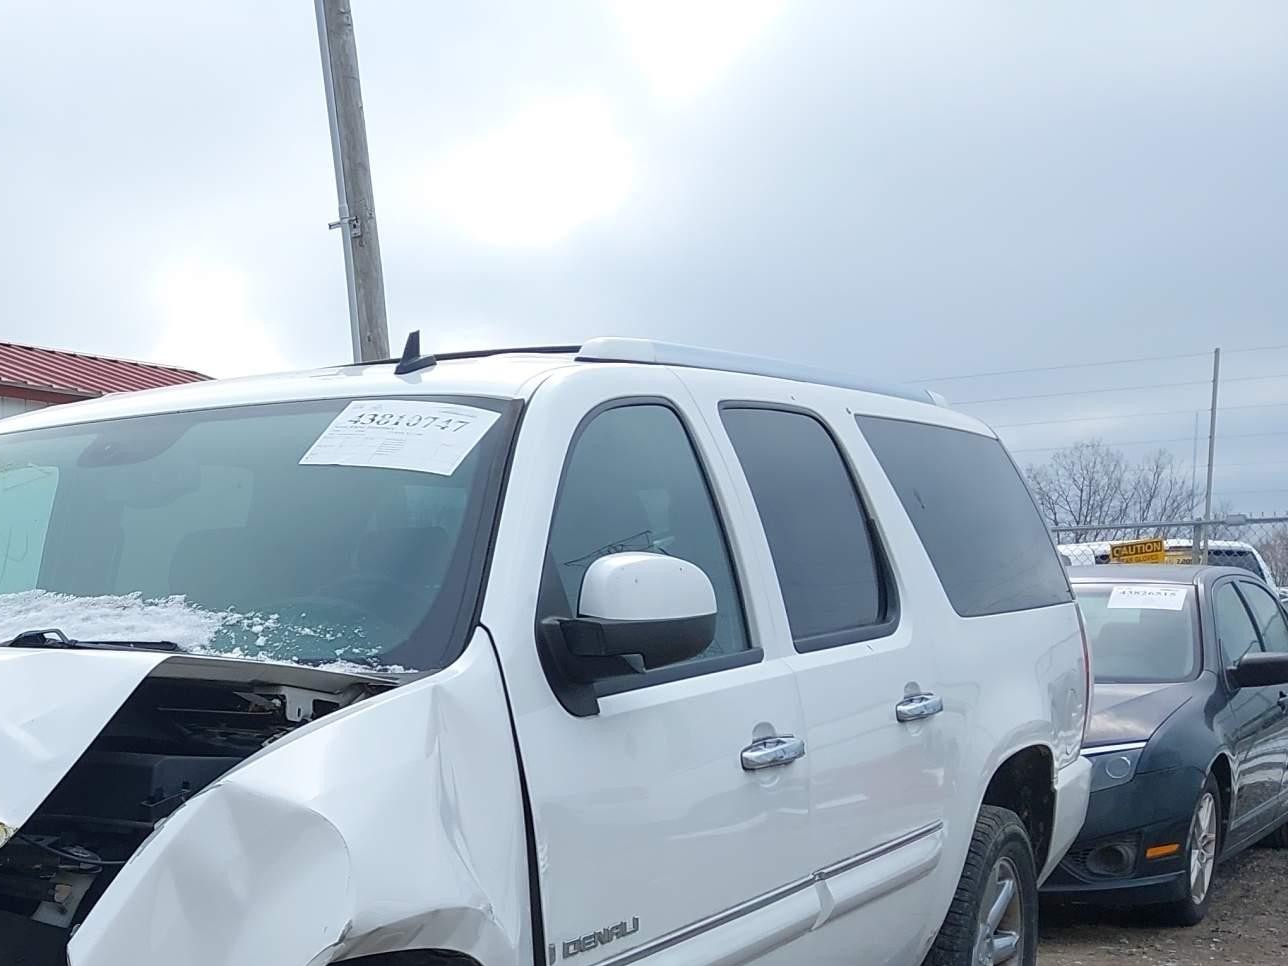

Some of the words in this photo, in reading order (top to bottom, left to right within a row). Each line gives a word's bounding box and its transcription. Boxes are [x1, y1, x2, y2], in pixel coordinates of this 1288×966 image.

[348, 412, 471, 433] 43810747
[1113, 542, 1161, 557] CAUTION
[562, 915, 640, 960] DENALI
